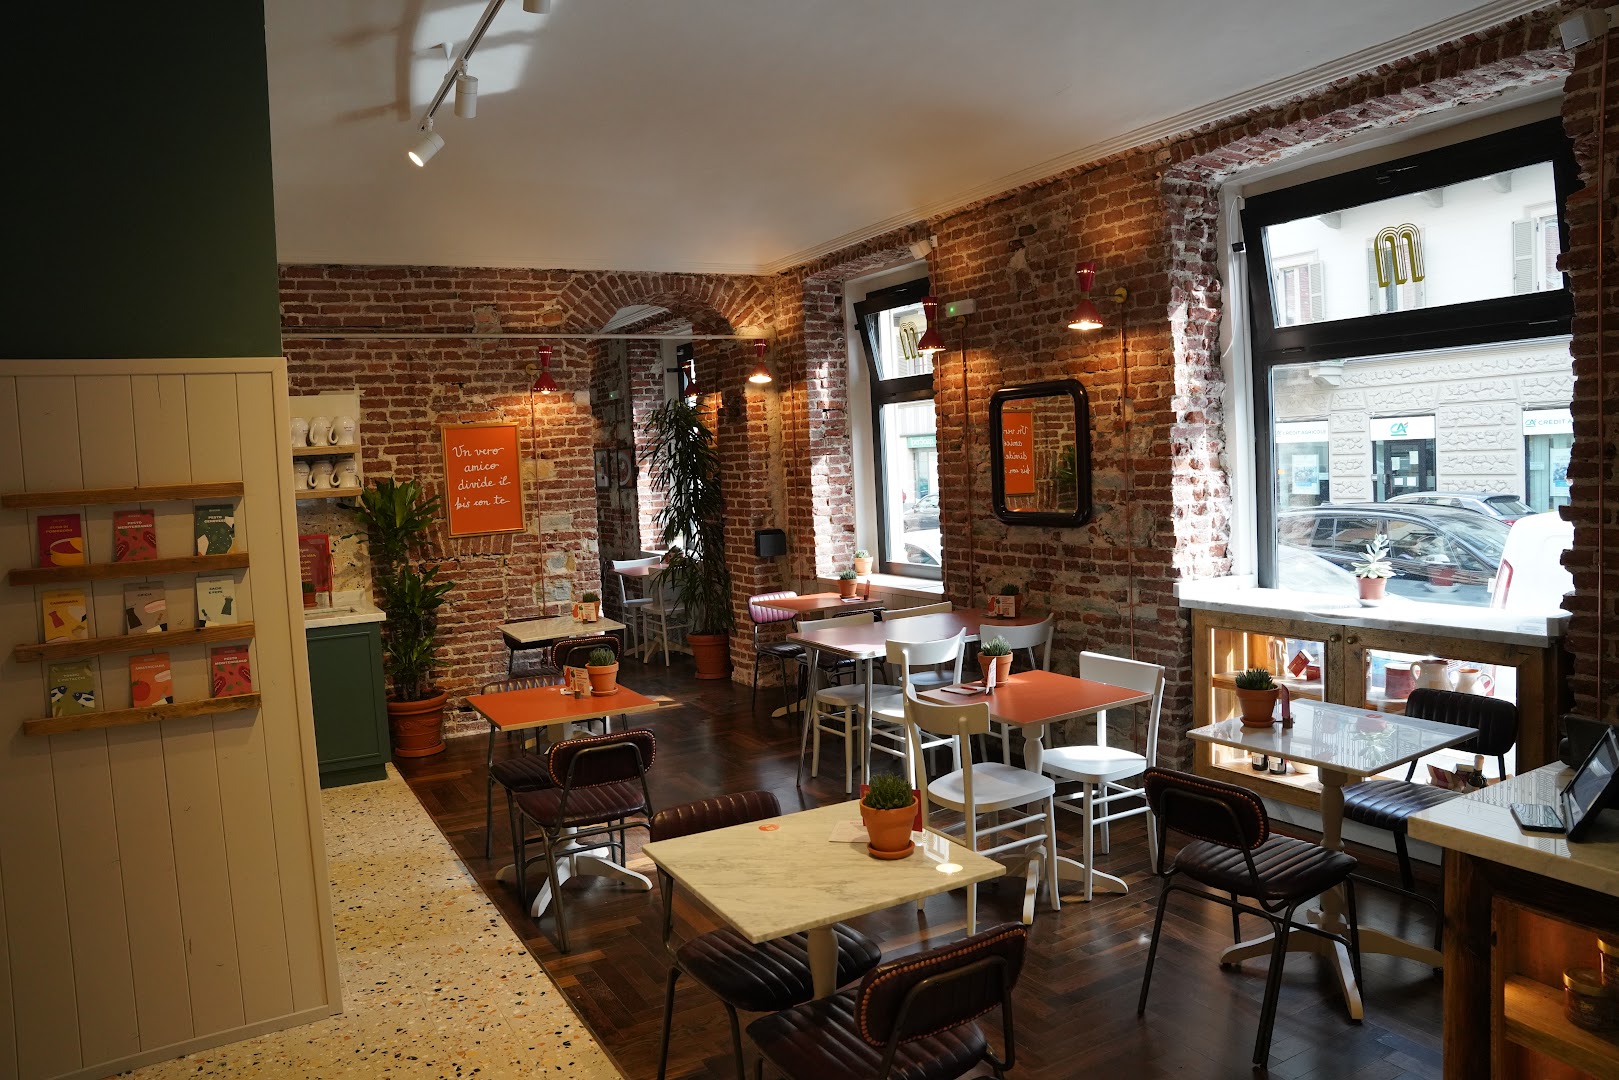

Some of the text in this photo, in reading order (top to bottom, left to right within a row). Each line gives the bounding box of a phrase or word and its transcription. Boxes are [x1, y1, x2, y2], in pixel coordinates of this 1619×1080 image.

[452, 444, 505, 458] Un vero
[464, 461, 500, 473] amico
[457, 475, 512, 490] divide il
[454, 496, 471, 510] bis
[493, 494, 511, 505] te
